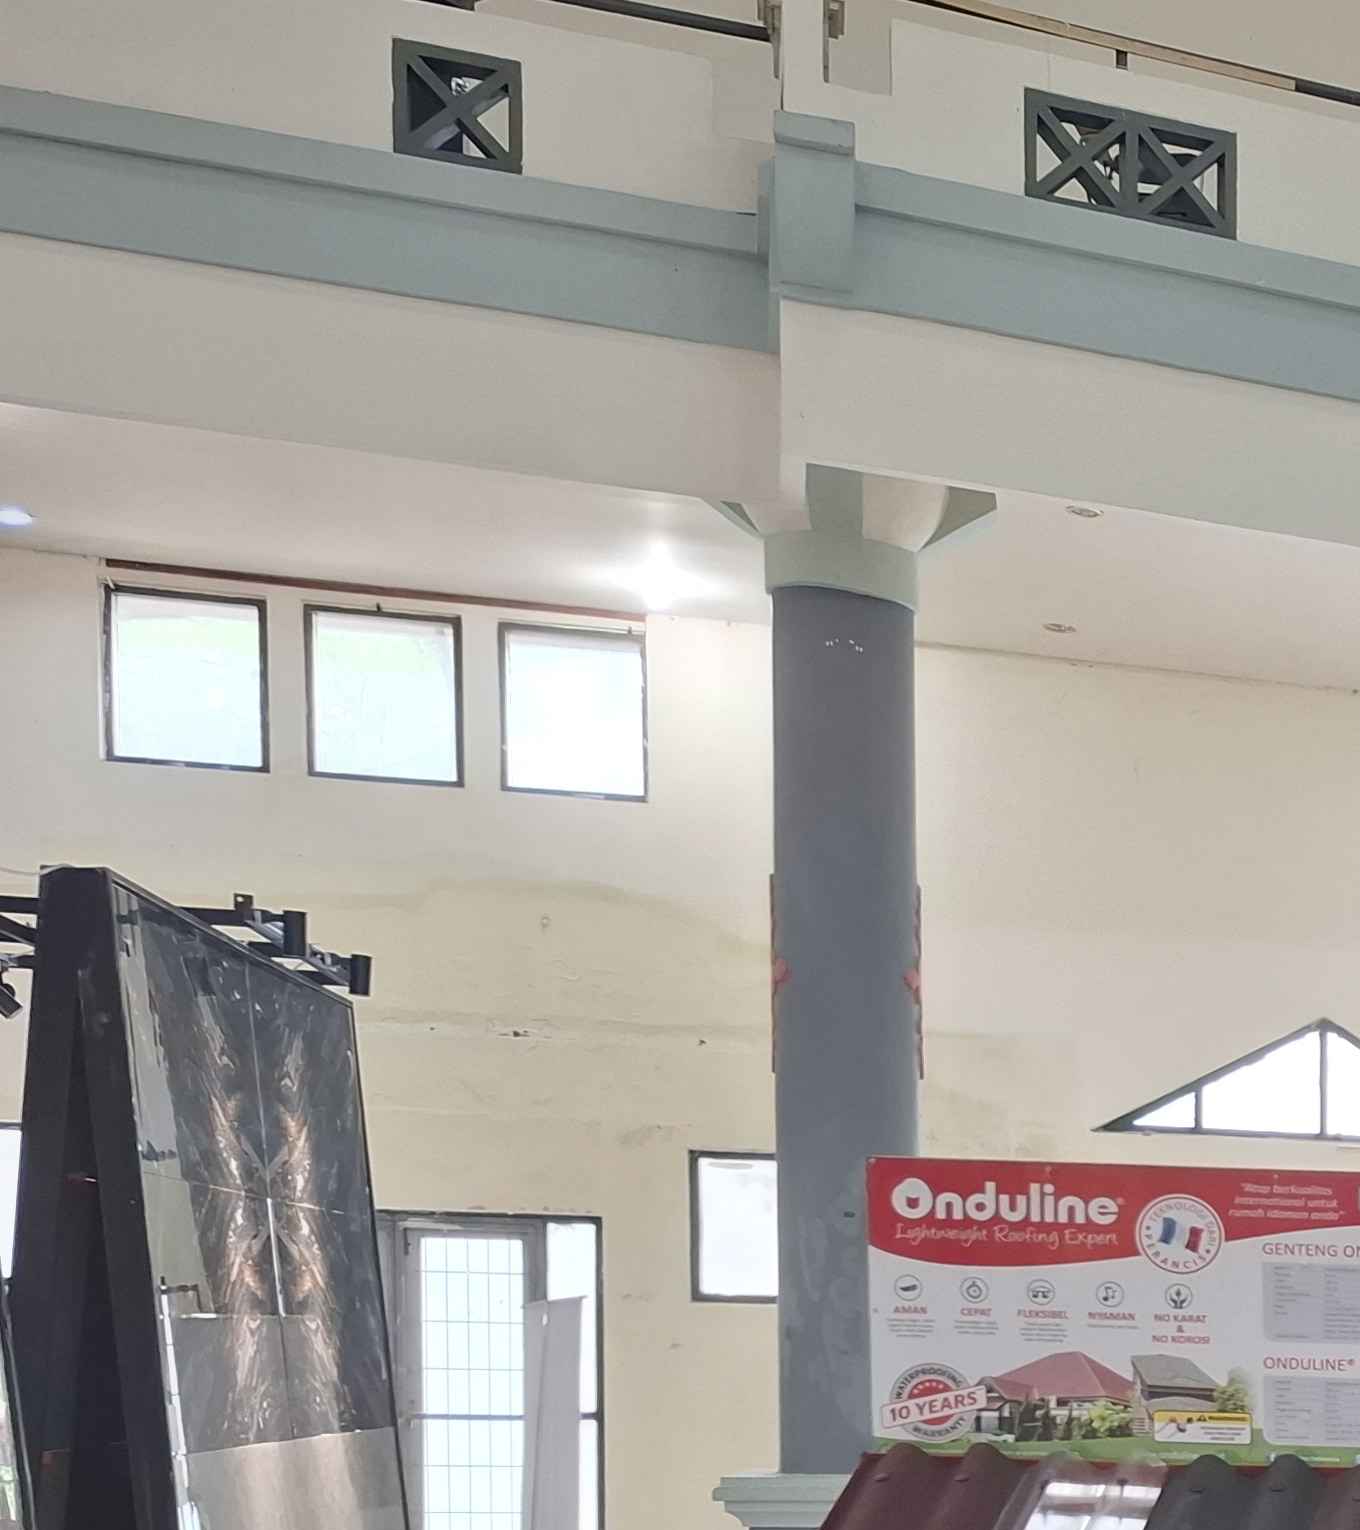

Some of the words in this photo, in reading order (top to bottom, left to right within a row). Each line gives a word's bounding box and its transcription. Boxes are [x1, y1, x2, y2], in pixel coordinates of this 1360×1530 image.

[891, 1177, 1120, 1225] Onduline
[1152, 1201, 1208, 1224] TEKNOLOGI
[895, 1223, 988, 1247] Lightweight
[993, 1225, 1059, 1249] Roofing
[1065, 1229, 1118, 1249] Expert
[1205, 1217, 1217, 1247] DARI
[1145, 1231, 1207, 1270] PERANCIS
[1262, 1243, 1339, 1258] GENTENG
[893, 1305, 929, 1316] AMAN
[960, 1307, 992, 1318] CEPAT
[1017, 1309, 1071, 1320] FLEKSIBEL
[1153, 1313, 1170, 1324] NO
[1173, 1314, 1208, 1325] KARAT
[1152, 1335, 1170, 1345] NO
[1173, 1335, 1211, 1346] KOROSI
[895, 1367, 964, 1400] WATERPROOFING
[889, 1404, 911, 1423] 10
[913, 1391, 979, 1416] YEARS
[911, 1416, 968, 1438] WARRANTY
